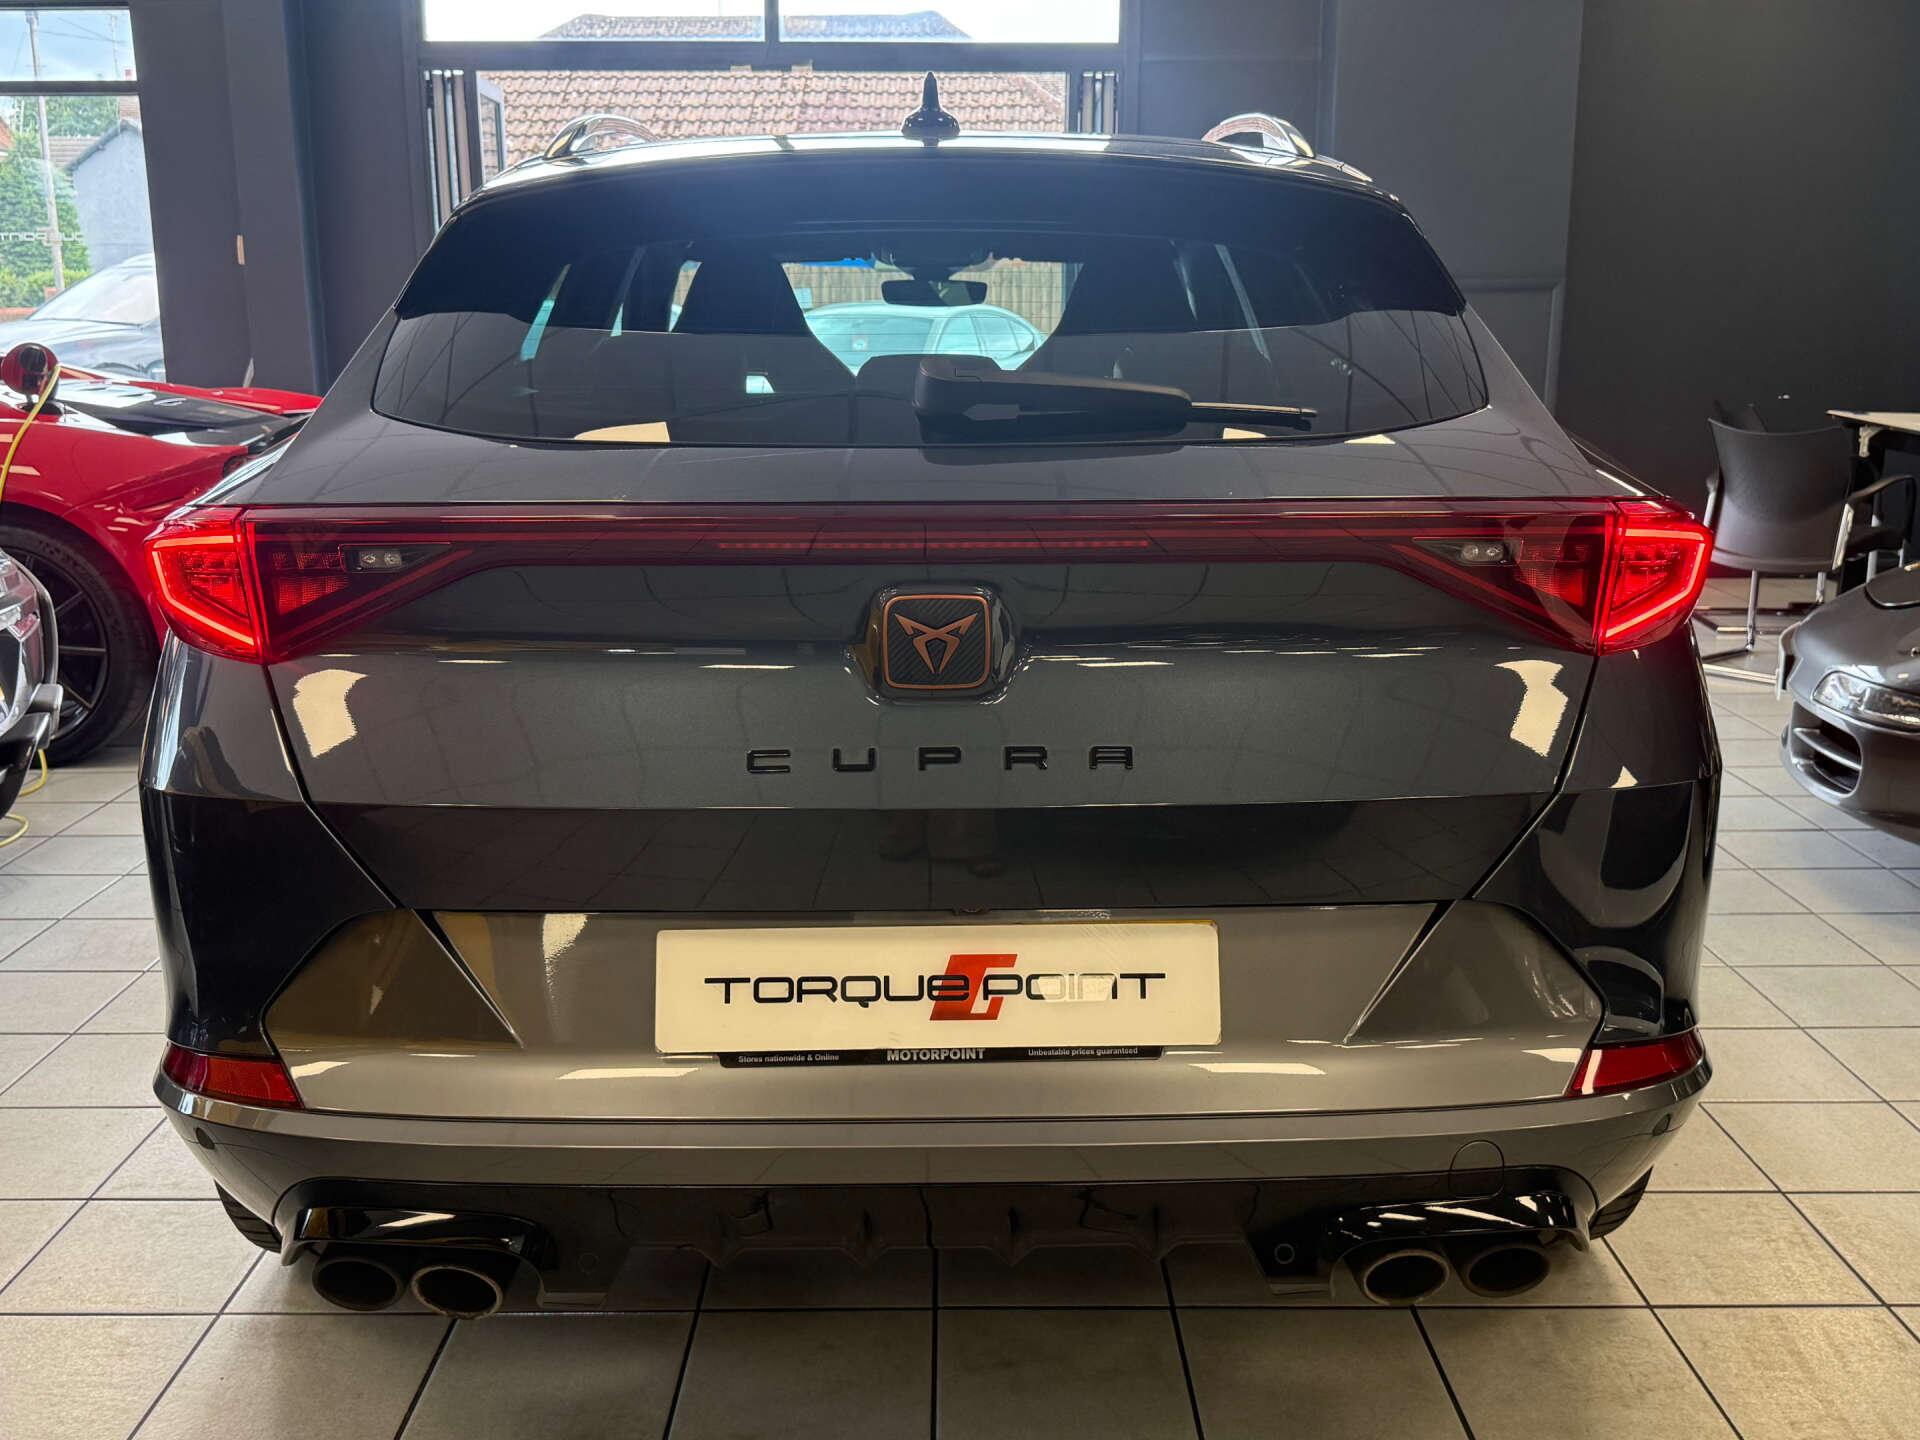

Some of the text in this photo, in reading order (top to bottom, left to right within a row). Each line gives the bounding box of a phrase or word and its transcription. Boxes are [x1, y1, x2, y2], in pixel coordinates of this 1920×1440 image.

[746, 745, 1133, 773] CUPRA
[704, 973, 1166, 1008] TORQUE POINT
[738, 1052, 840, 1063] Stores nationwide & Online
[886, 1047, 986, 1061] MOTORPOINT
[1028, 1047, 1139, 1057] Unbeatable prices guaranteed
